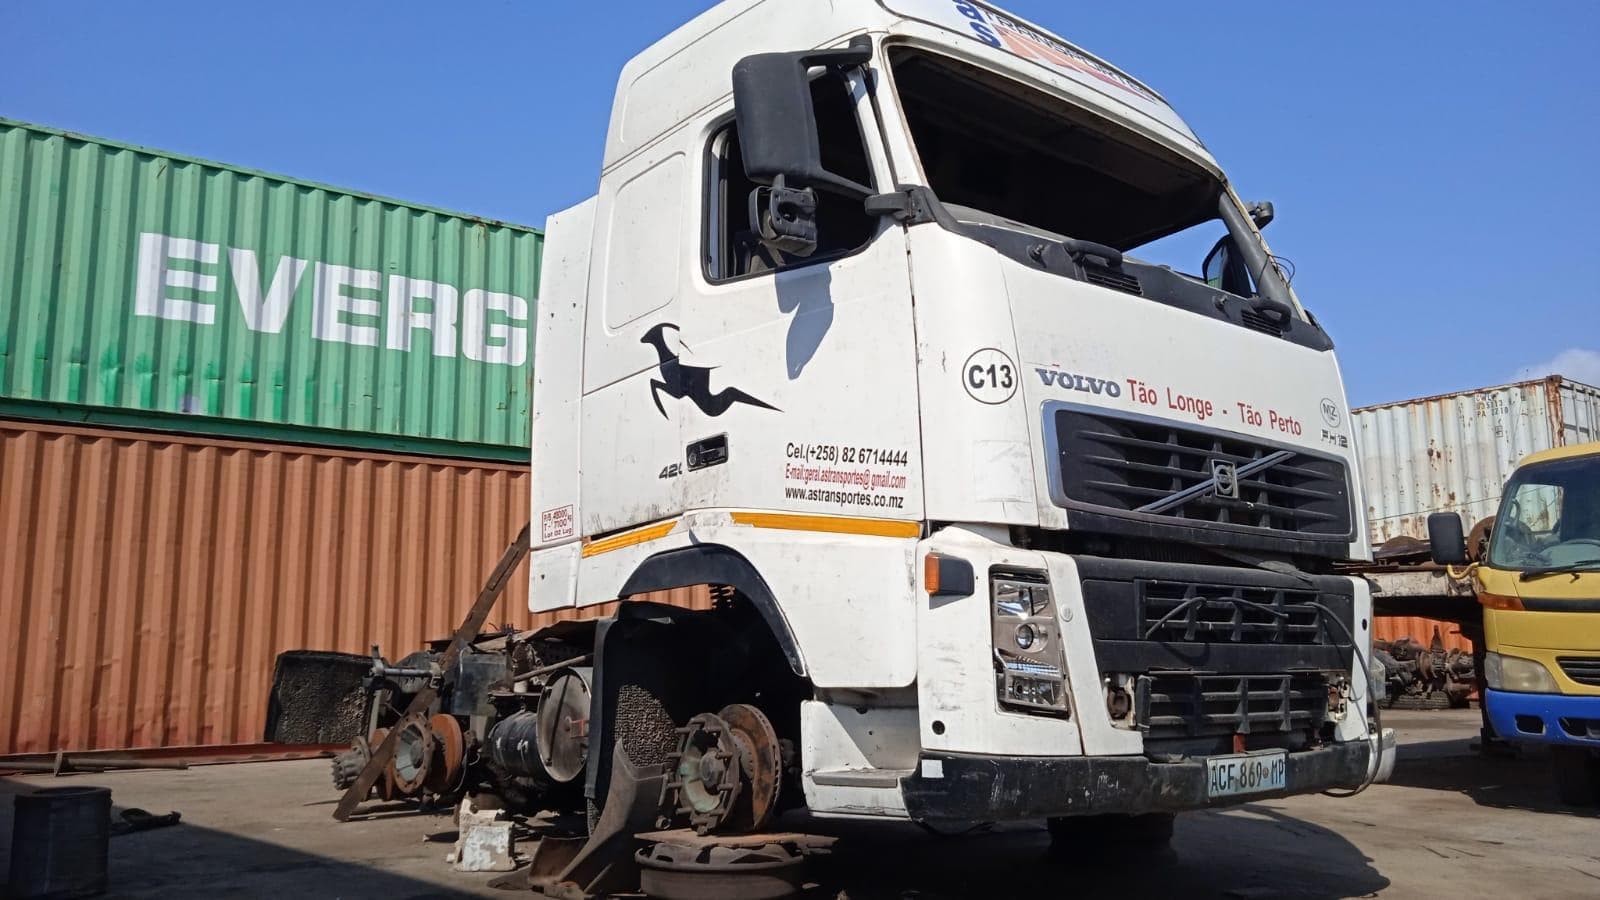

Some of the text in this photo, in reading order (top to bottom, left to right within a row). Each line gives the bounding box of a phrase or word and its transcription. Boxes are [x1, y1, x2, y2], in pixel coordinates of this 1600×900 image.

[134, 232, 537, 367] EVERG
[969, 364, 1013, 389] C13
[1035, 368, 1121, 398] VOLVO
[1127, 379, 1157, 405] Tão
[1167, 387, 1213, 420] Longe
[1237, 402, 1262, 427] Tão
[1269, 410, 1302, 436] Perto
[1322, 403, 1337, 418] MZ
[1321, 429, 1348, 449] FH12
[786, 442, 908, 468] Cel.(+258) 82 6714444
[785, 486, 904, 509] www.astransportes.co.mz
[1211, 758, 1285, 793] ACF 869 MP
